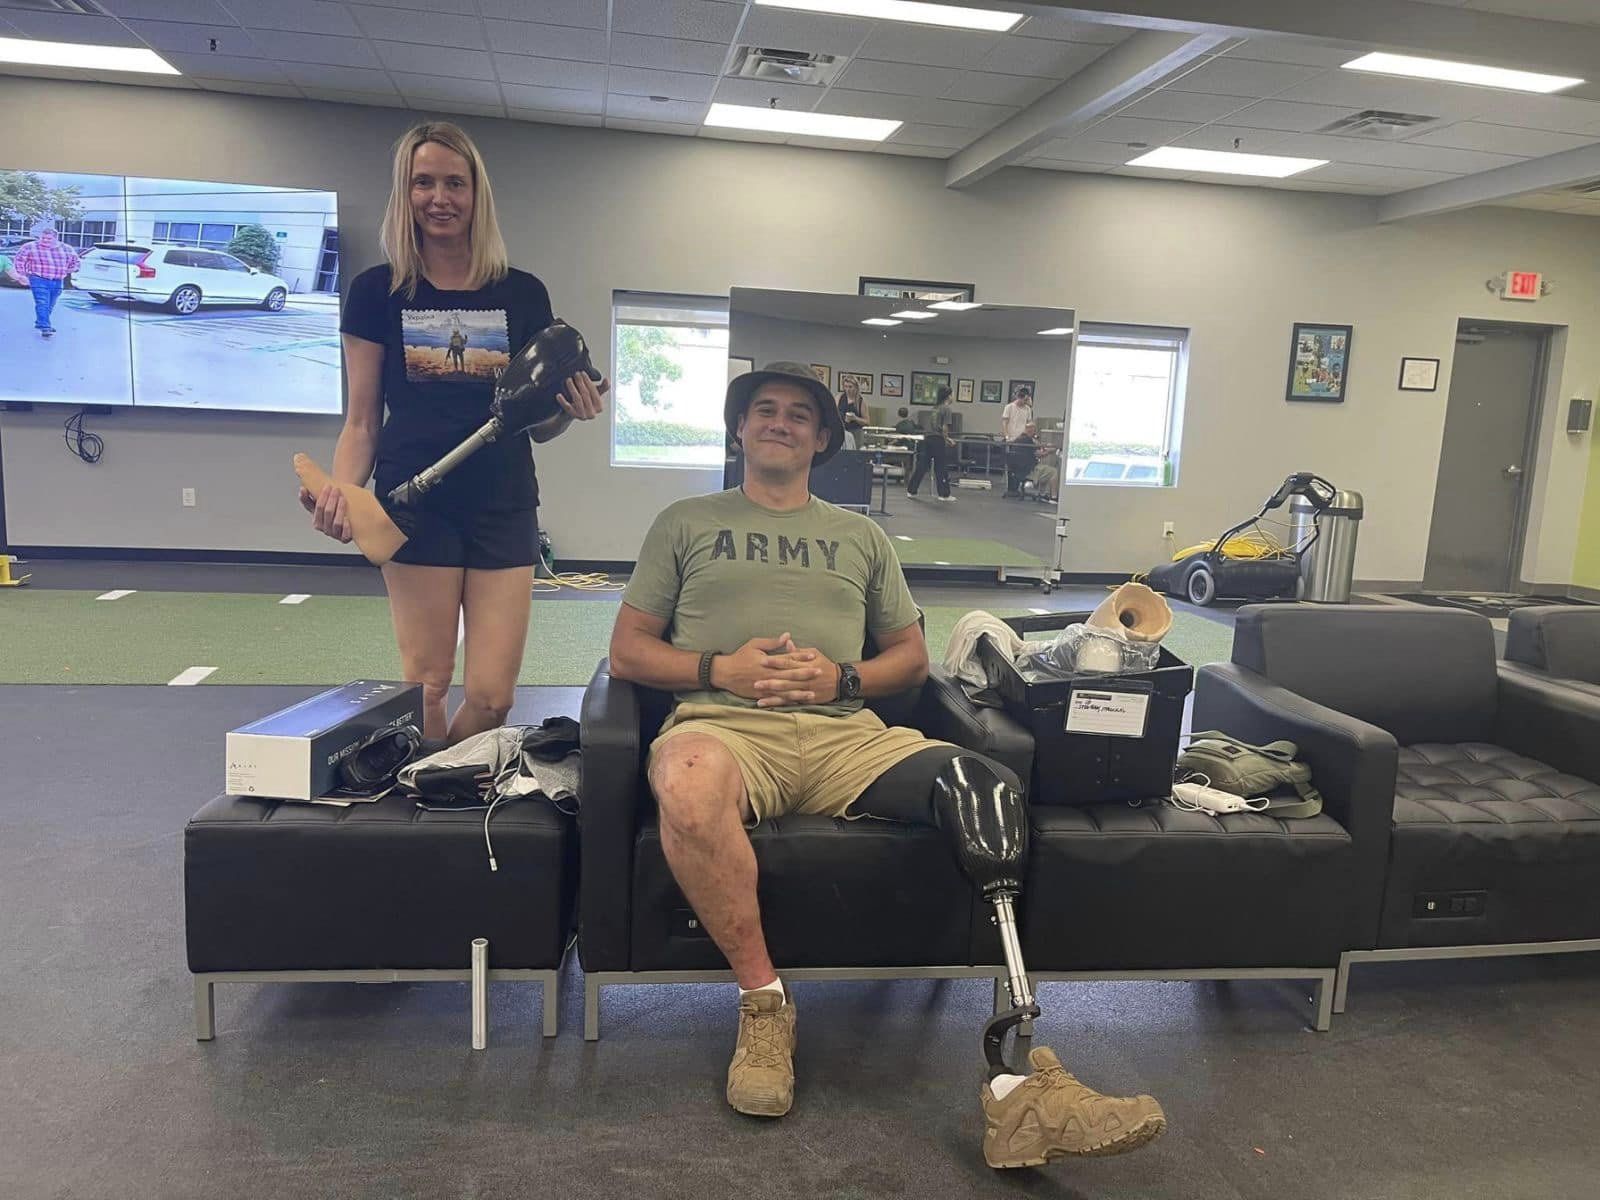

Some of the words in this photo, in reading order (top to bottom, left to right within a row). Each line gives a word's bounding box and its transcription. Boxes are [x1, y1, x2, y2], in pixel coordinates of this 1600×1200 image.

[1511, 272, 1537, 295] EXIT
[709, 529, 840, 571] ARMY
[327, 752, 339, 766] OUR
